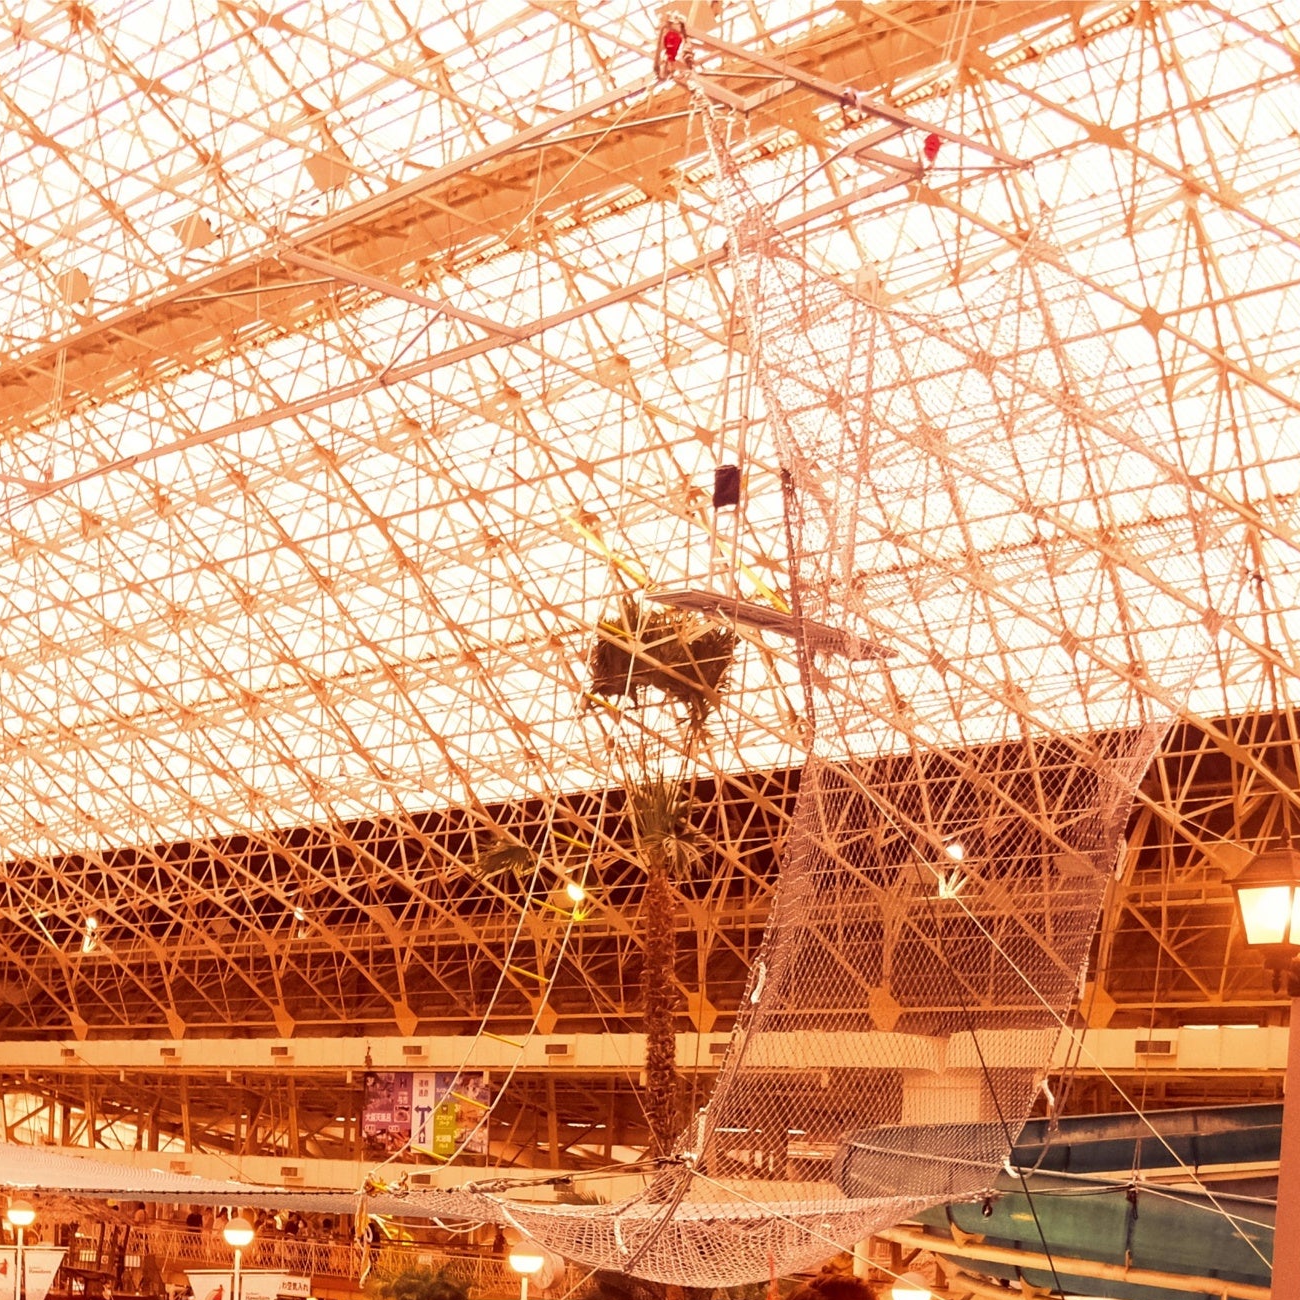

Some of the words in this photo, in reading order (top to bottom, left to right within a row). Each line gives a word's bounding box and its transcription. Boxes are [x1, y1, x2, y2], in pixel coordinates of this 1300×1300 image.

[279, 1281, 309, 1292] わ空気入れ
